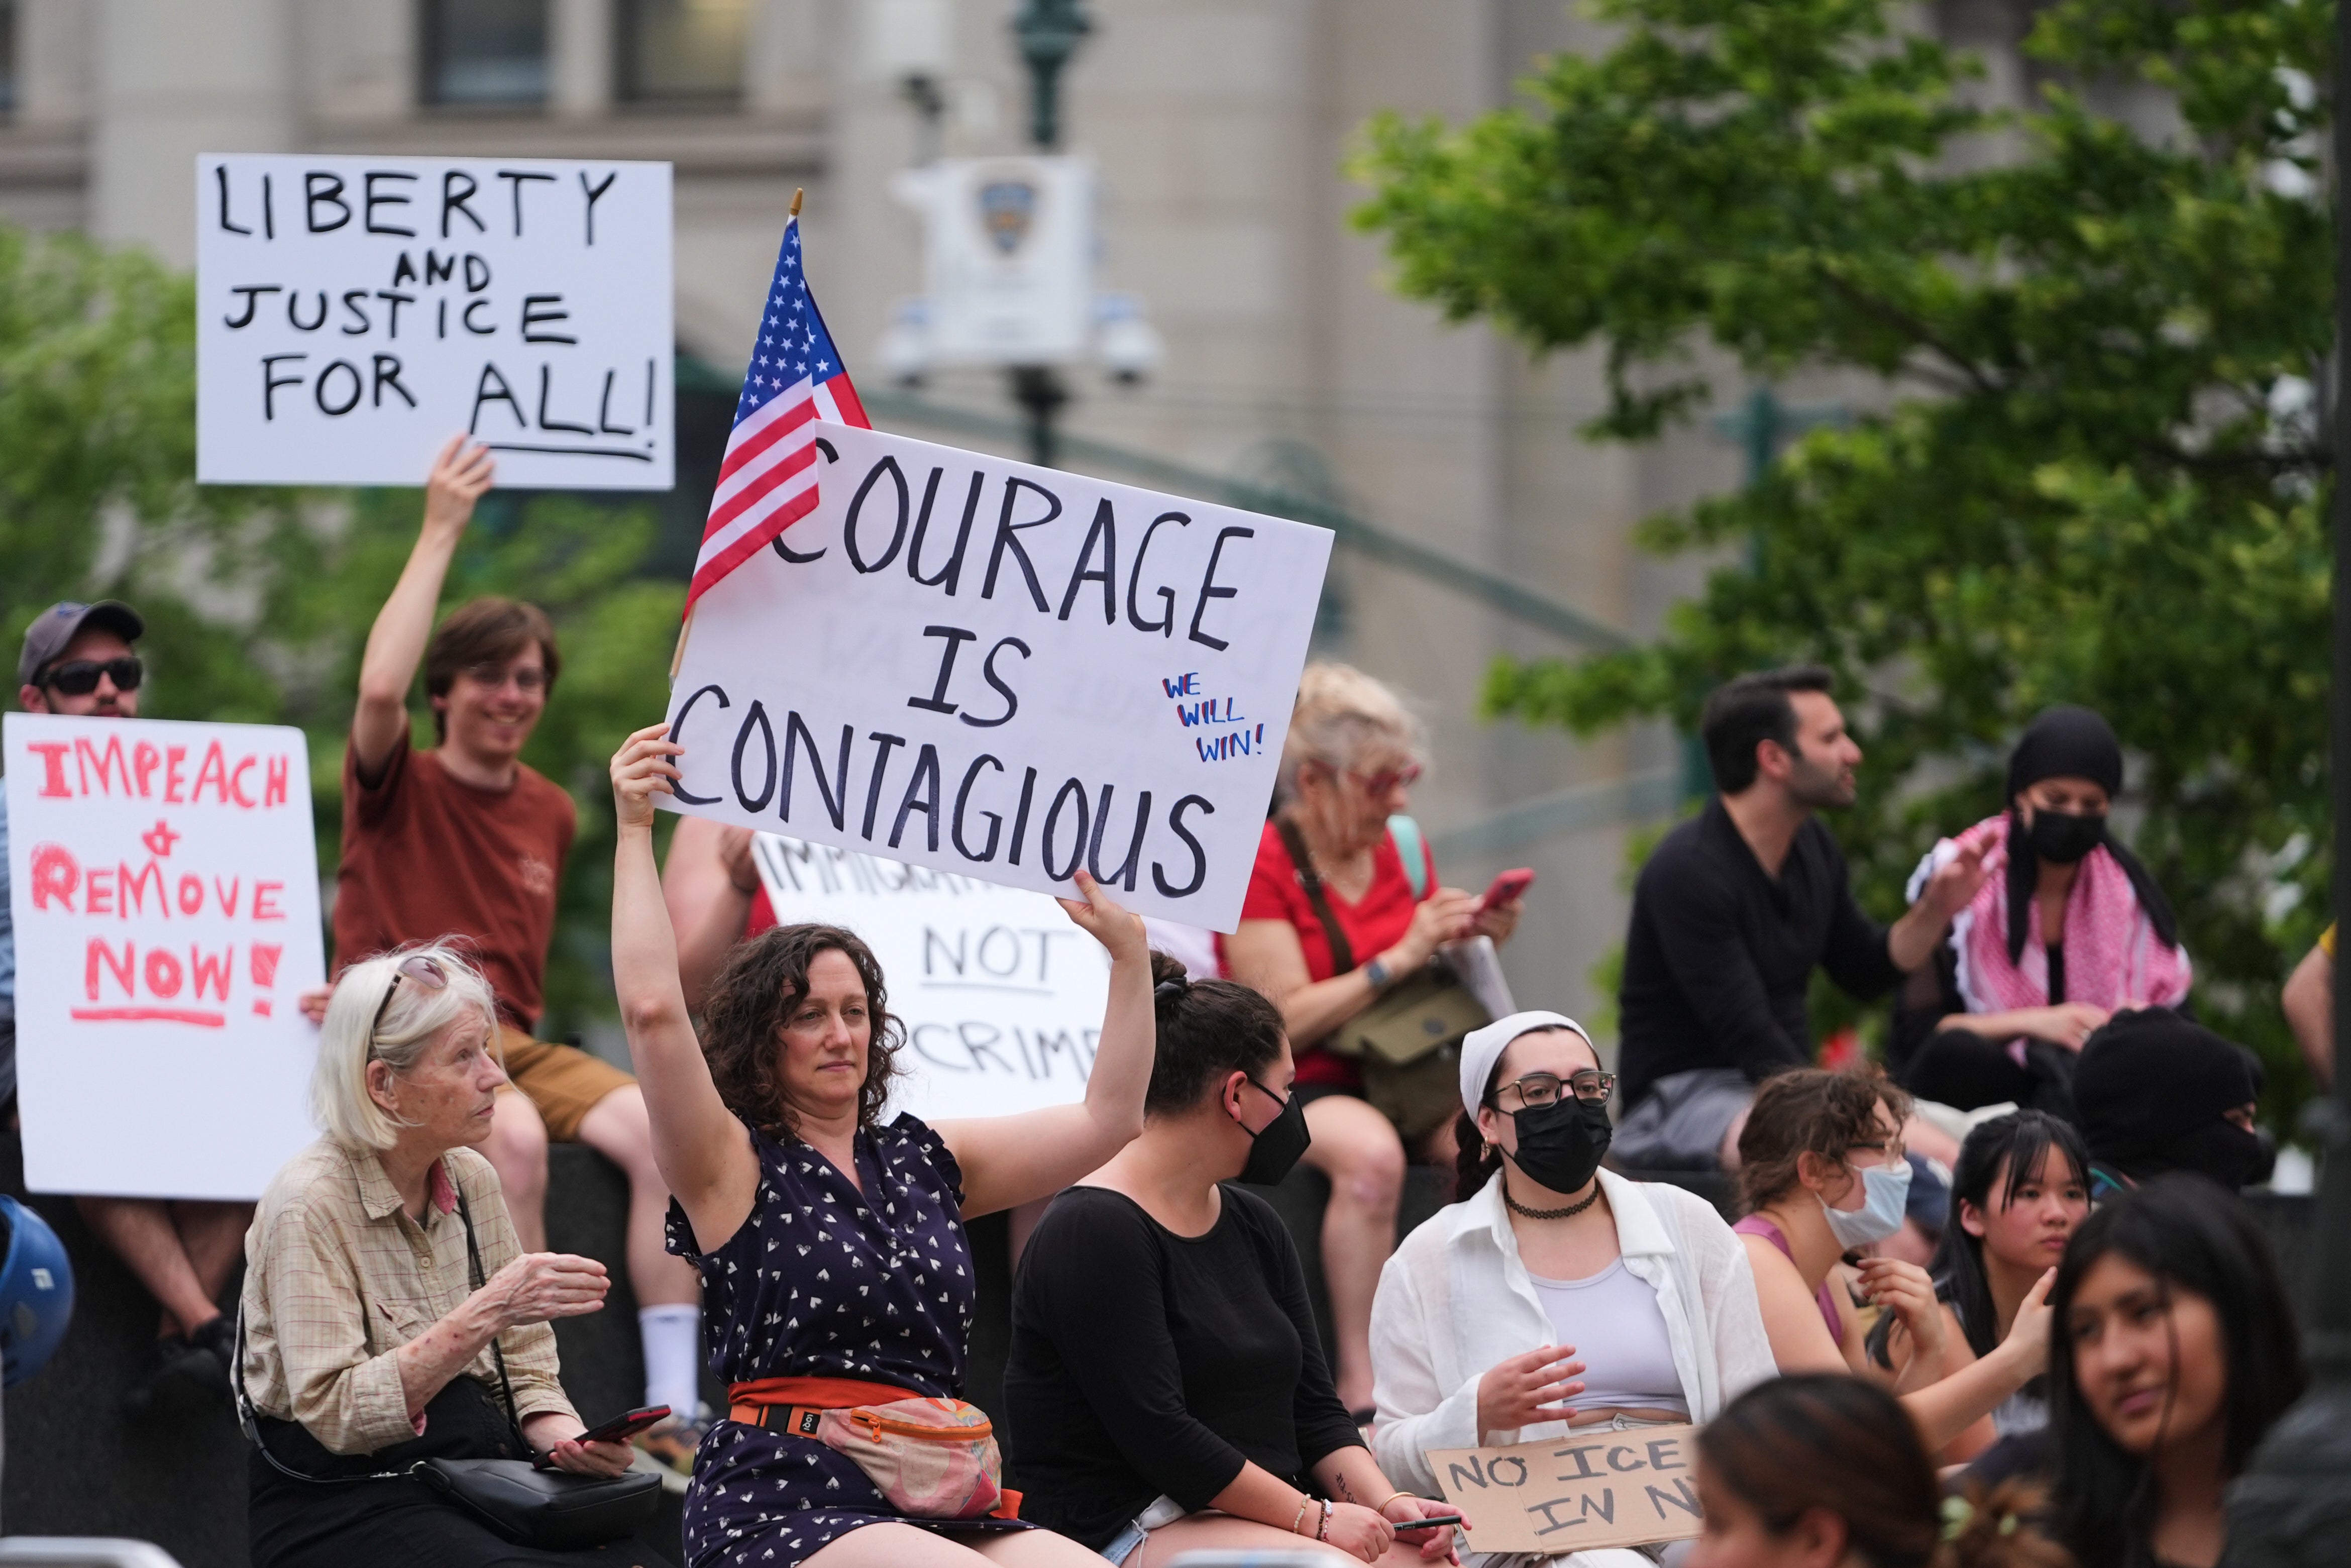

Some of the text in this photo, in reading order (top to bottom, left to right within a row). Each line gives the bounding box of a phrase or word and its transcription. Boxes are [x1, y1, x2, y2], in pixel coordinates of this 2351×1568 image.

[216, 163, 617, 246] LIBERTY
[394, 249, 490, 293] AND
[224, 285, 578, 345] JUSTICE
[261, 352, 656, 449] FOR ALL!
[907, 624, 1032, 727] IS
[1162, 672, 1201, 699] WE
[1177, 697, 1245, 727] WILL
[27, 733, 288, 808] IMPEACH
[1196, 723, 1264, 763] WIN!
[665, 684, 1215, 899] CONTAGIOUS
[30, 840, 286, 920] REMOVE
[84, 935, 283, 1017] NOW!
[922, 925, 1076, 983] NOT
[1448, 1438, 1687, 1492] NO ICE
[1527, 1488, 1614, 1536] IN
